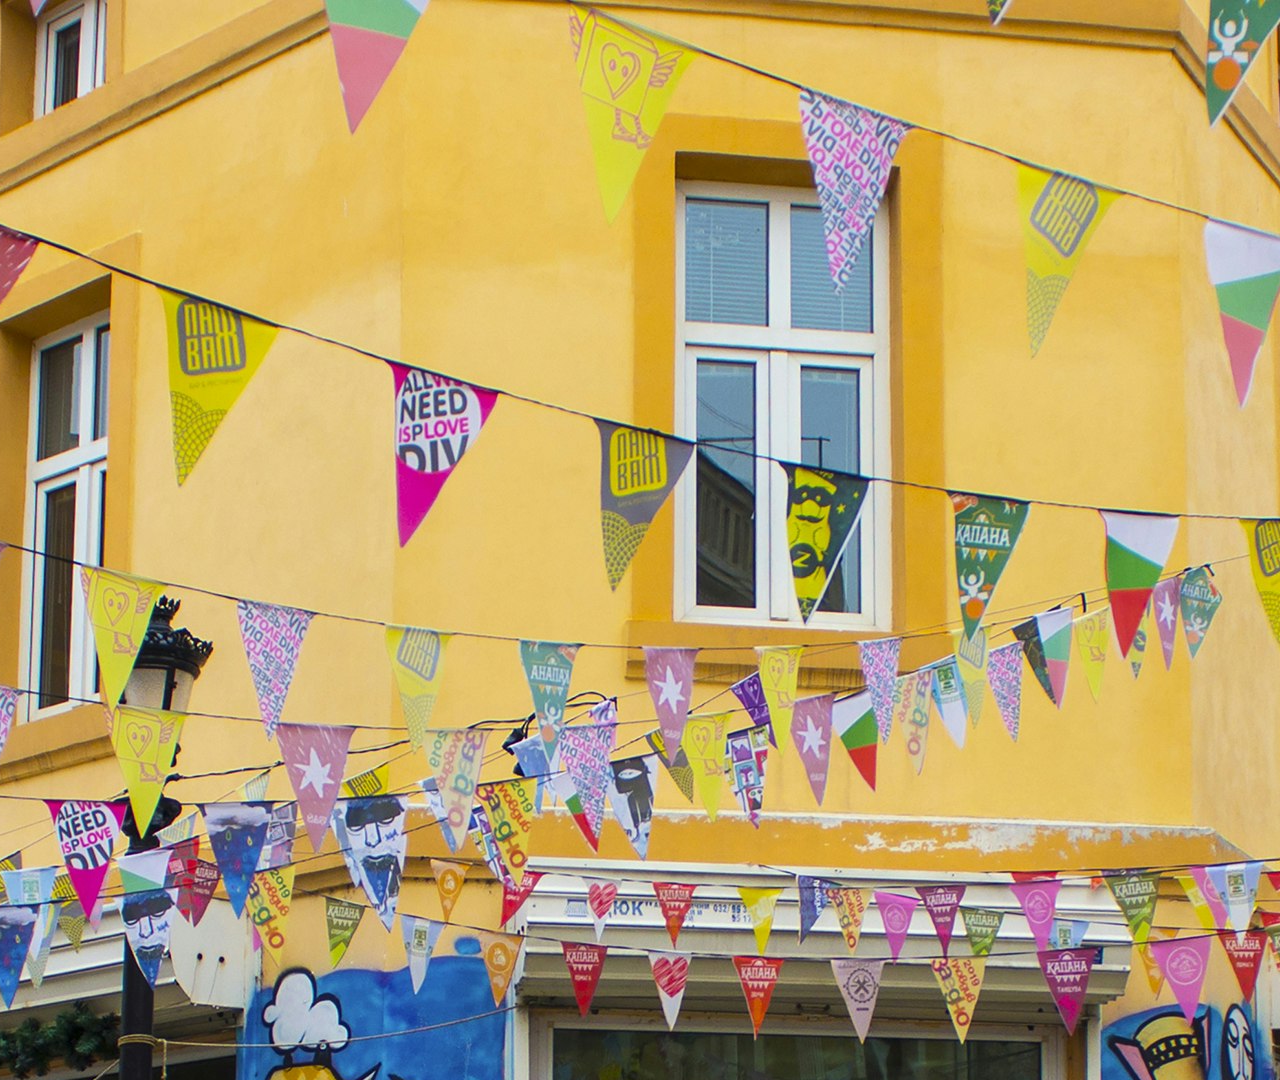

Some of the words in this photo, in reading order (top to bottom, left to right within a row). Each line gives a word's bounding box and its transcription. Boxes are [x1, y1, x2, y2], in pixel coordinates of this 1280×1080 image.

[400, 387, 468, 424] NEED
[956, 523, 1010, 546] КАПАНА
[511, 781, 533, 813] 2019
[59, 811, 106, 843] NEED
[659, 889, 690, 901] КАПАНА
[1114, 881, 1156, 897] КАПАНА
[926, 893, 957, 905] КАПАНА
[327, 906, 360, 920] КАПАНА
[966, 914, 1000, 926] КАПАНА
[1225, 938, 1261, 952] КАПАНА
[566, 951, 599, 964] КАПАНА
[741, 968, 777, 980] КАПАНА
[963, 960, 980, 986] 2019
[1046, 960, 1089, 975] КАПАНА
